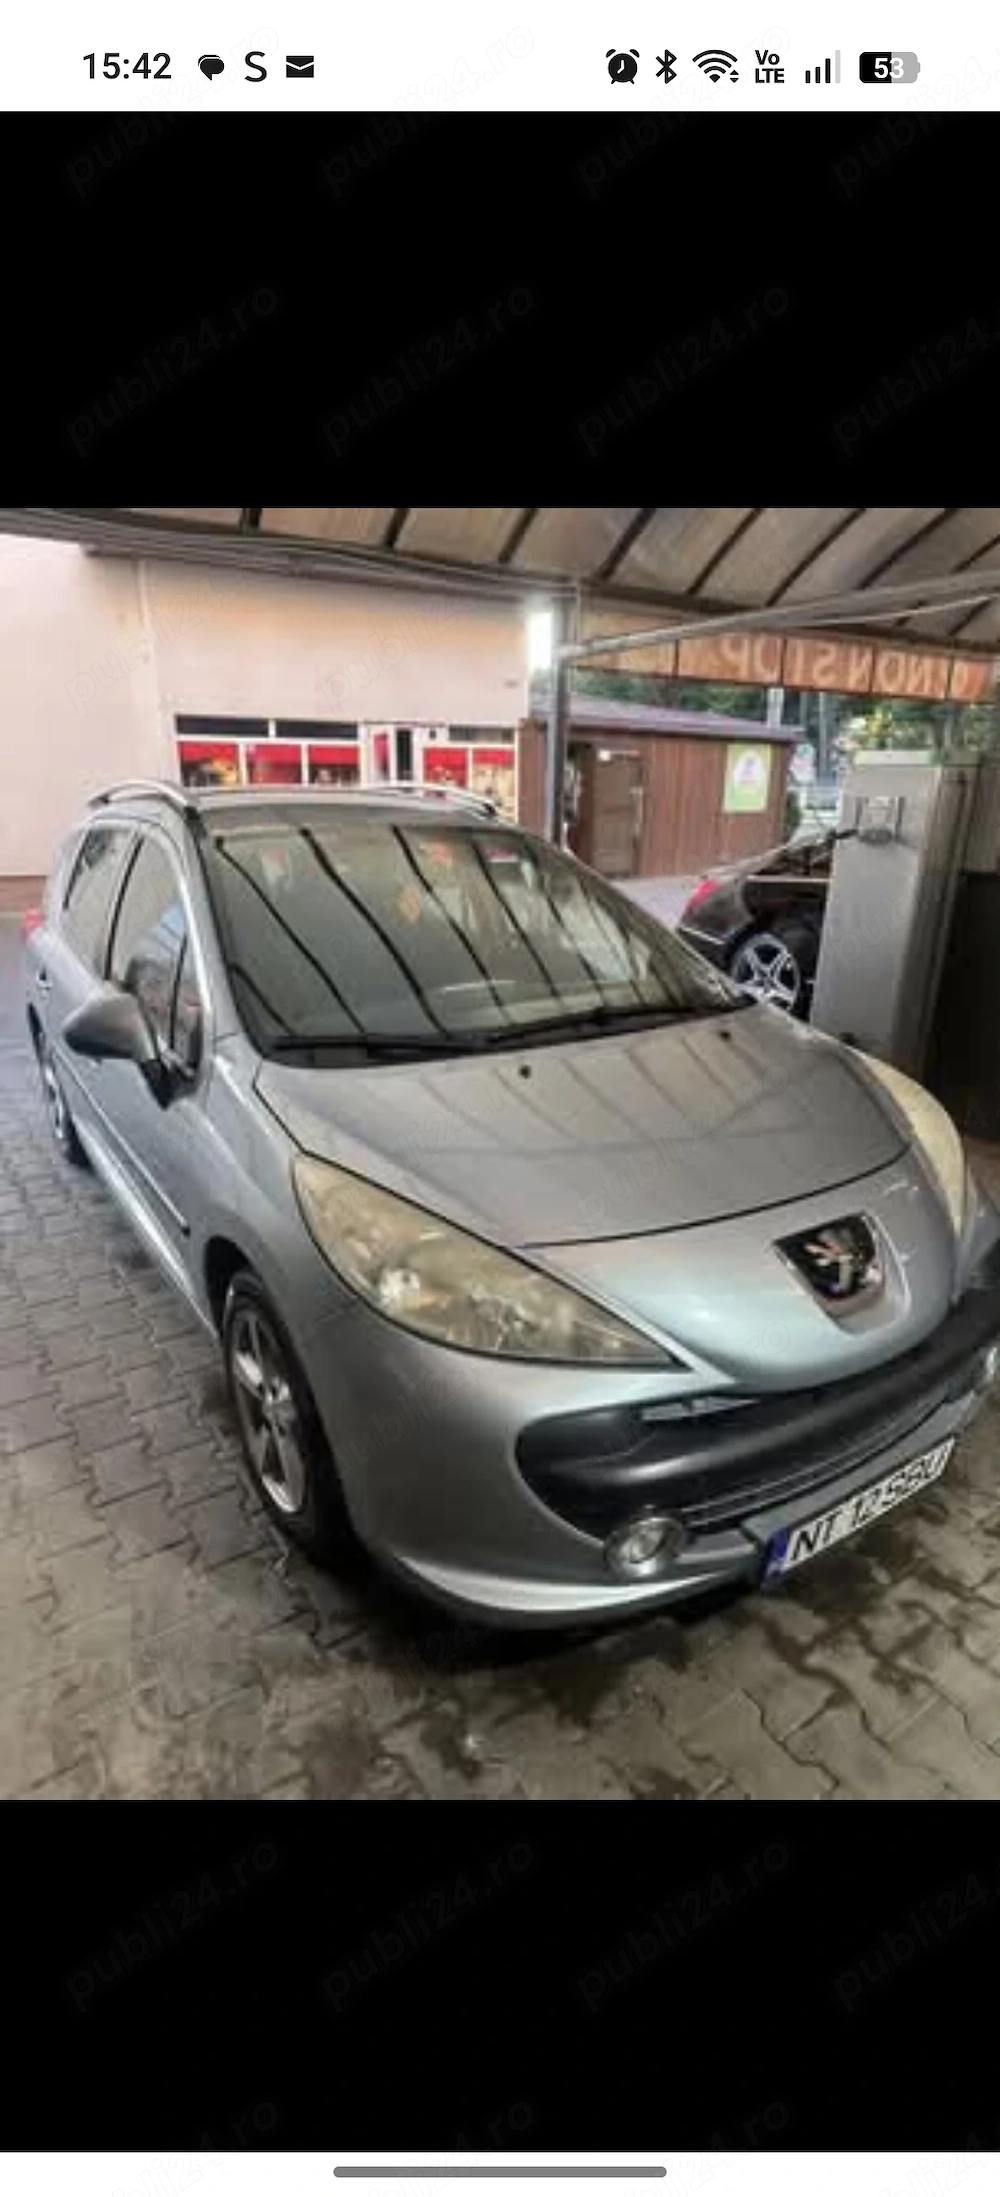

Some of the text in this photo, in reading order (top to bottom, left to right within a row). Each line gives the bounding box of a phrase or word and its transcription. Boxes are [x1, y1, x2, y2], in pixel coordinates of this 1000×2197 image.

[82, 52, 172, 80] 15:42
[754, 49, 781, 65] Vo
[754, 68, 785, 84] LTE
[873, 57, 905, 79] 53
